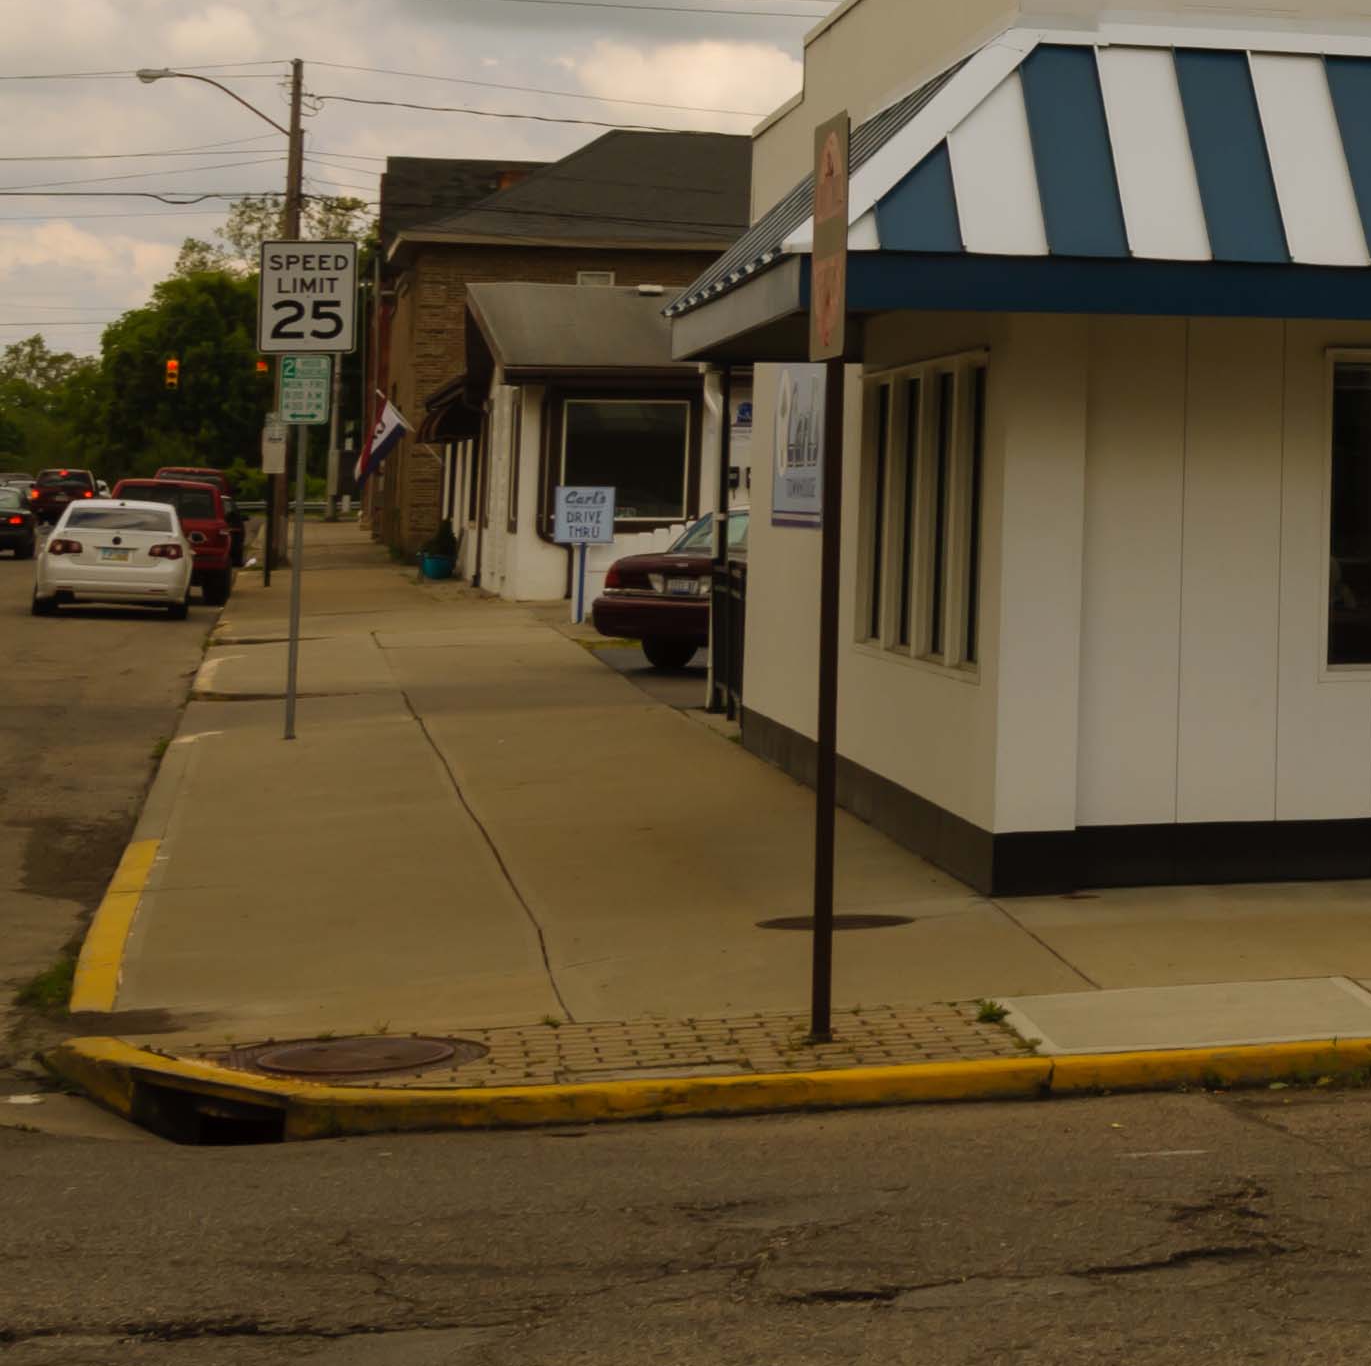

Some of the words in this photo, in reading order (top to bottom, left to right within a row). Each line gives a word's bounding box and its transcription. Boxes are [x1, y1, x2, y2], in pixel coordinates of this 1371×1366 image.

[269, 254, 348, 271] SPEED
[277, 277, 339, 294] LIMIT
[271, 300, 343, 339] 25
[283, 359, 295, 376] 2
[565, 490, 606, 504] Carl's
[566, 511, 602, 524] DRIVE
[568, 525, 600, 538] THRU
